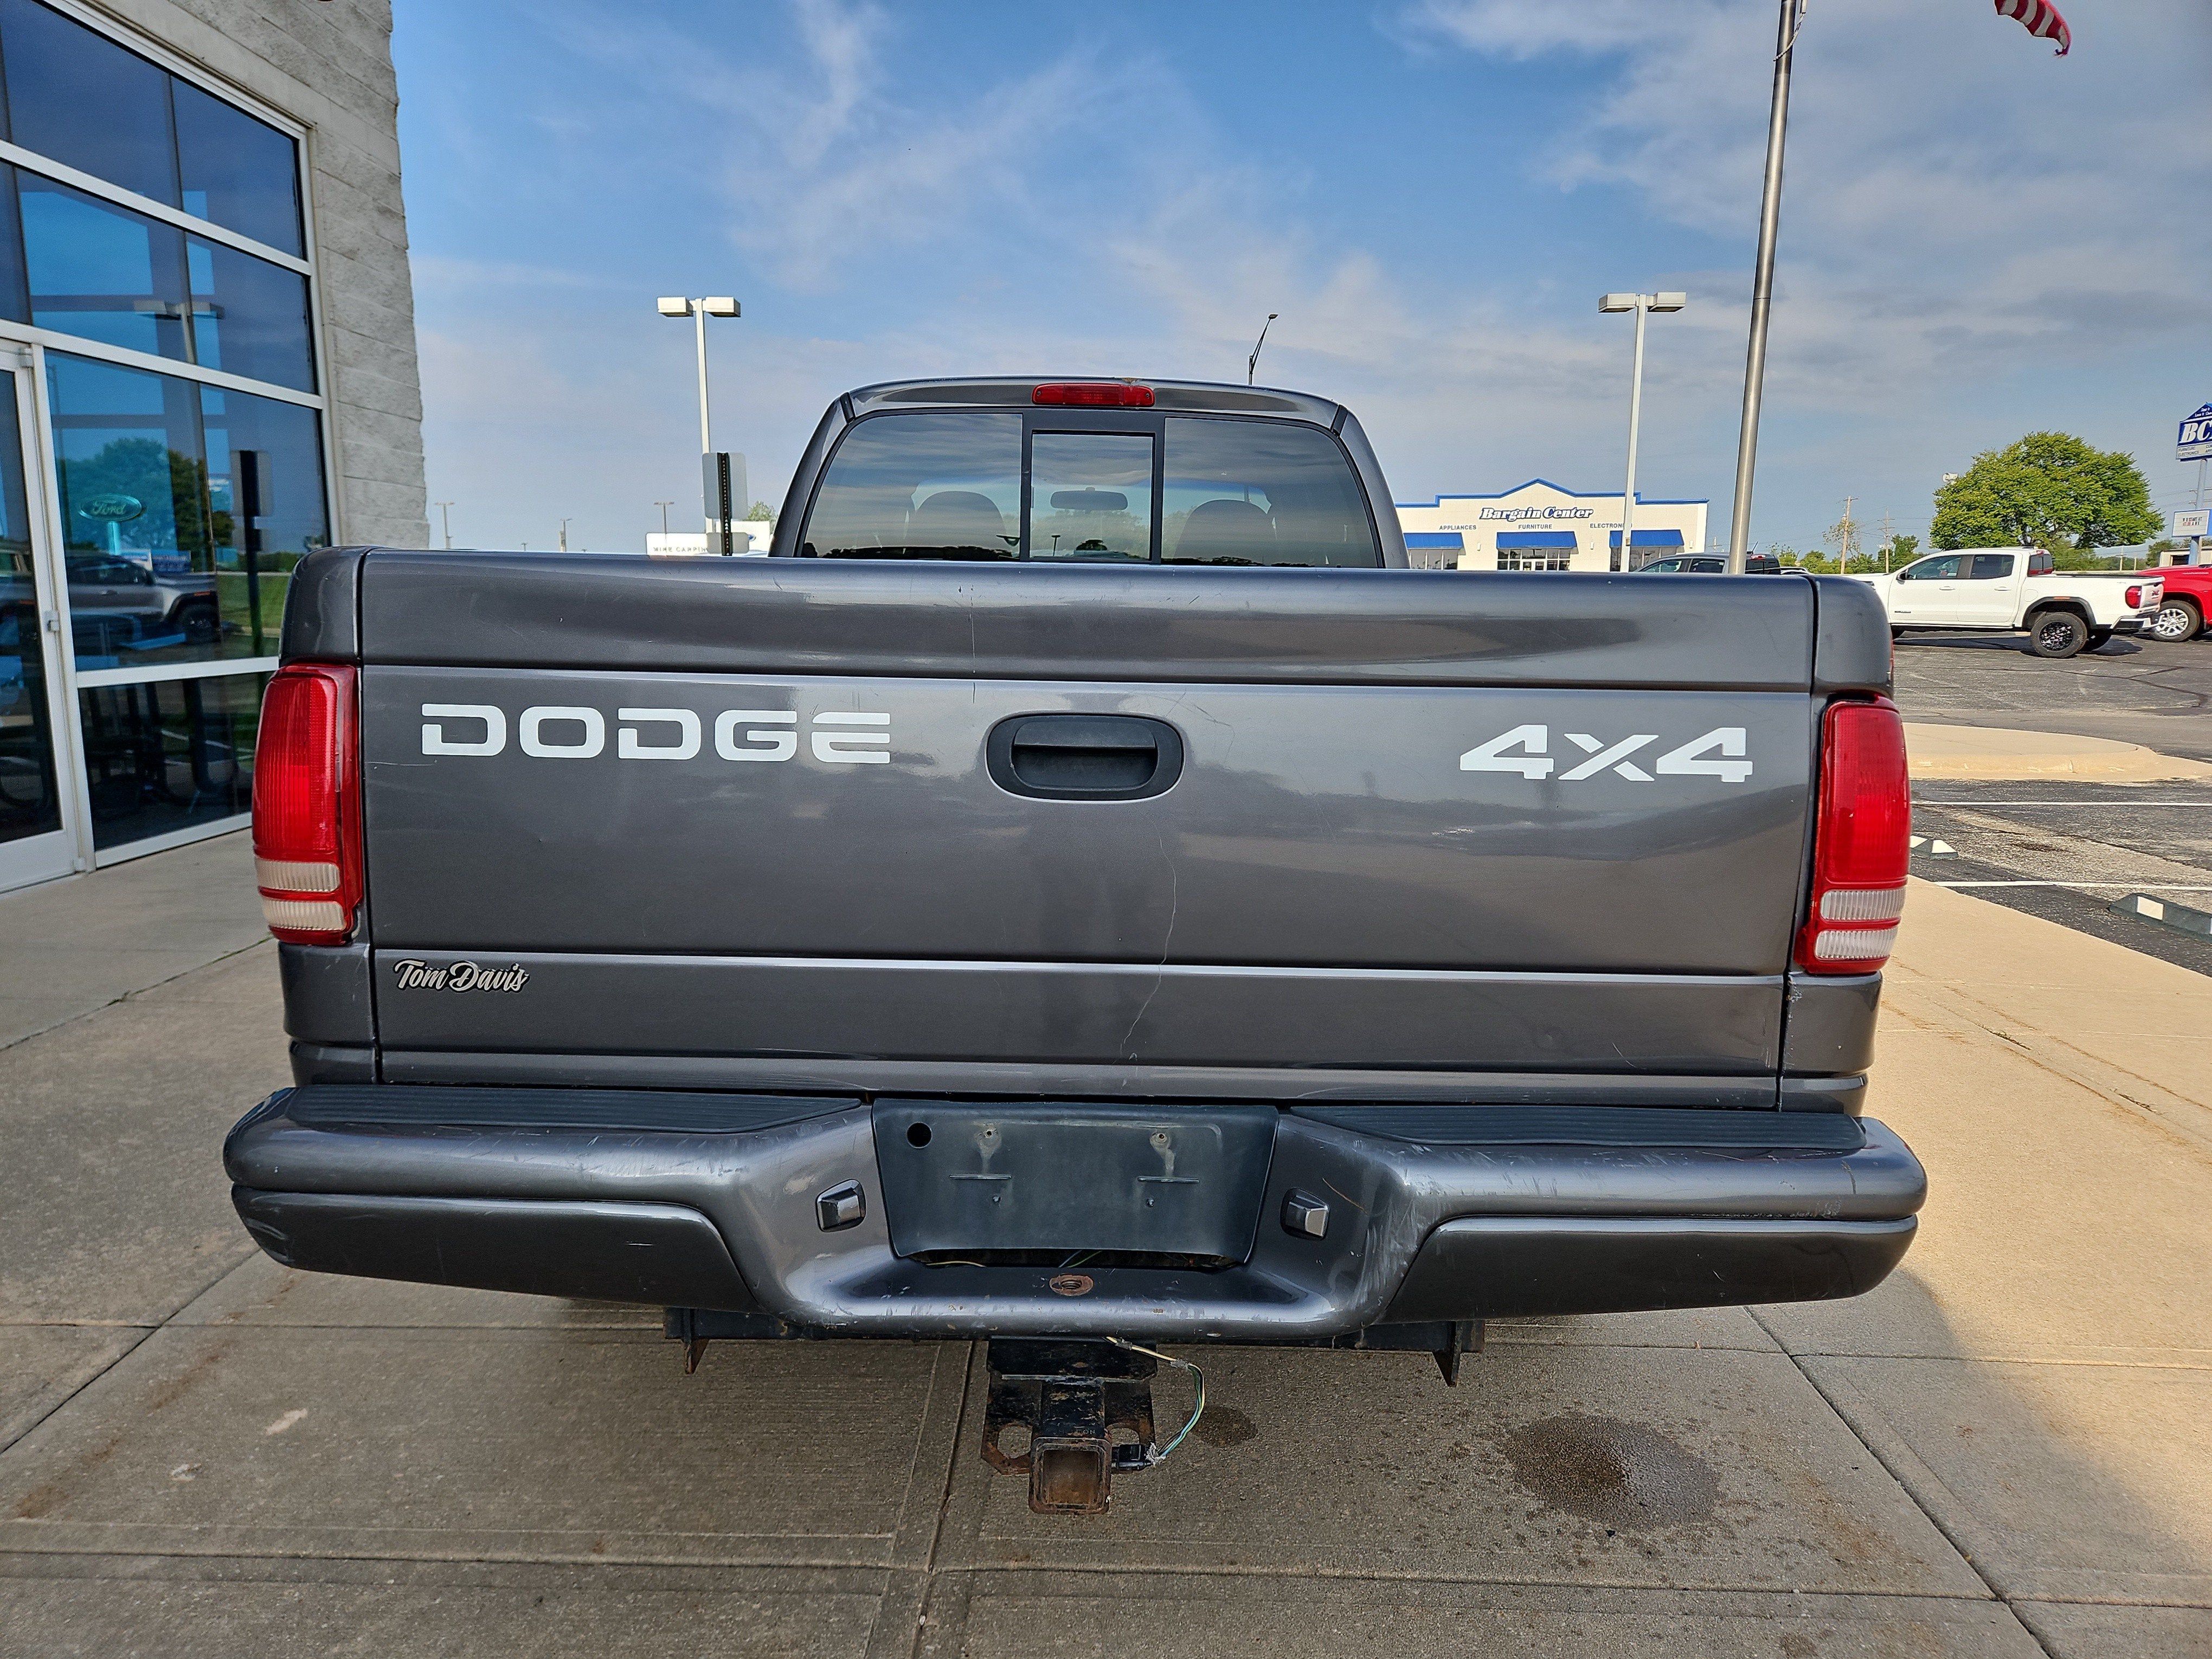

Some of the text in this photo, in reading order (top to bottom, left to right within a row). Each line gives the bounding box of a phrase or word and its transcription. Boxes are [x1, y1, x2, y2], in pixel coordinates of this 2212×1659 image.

[2179, 420, 2212, 443] BC
[1479, 506, 1593, 522] Bargain Center
[421, 703, 890, 764] DODGE
[393, 959, 530, 993] Tom Davis
